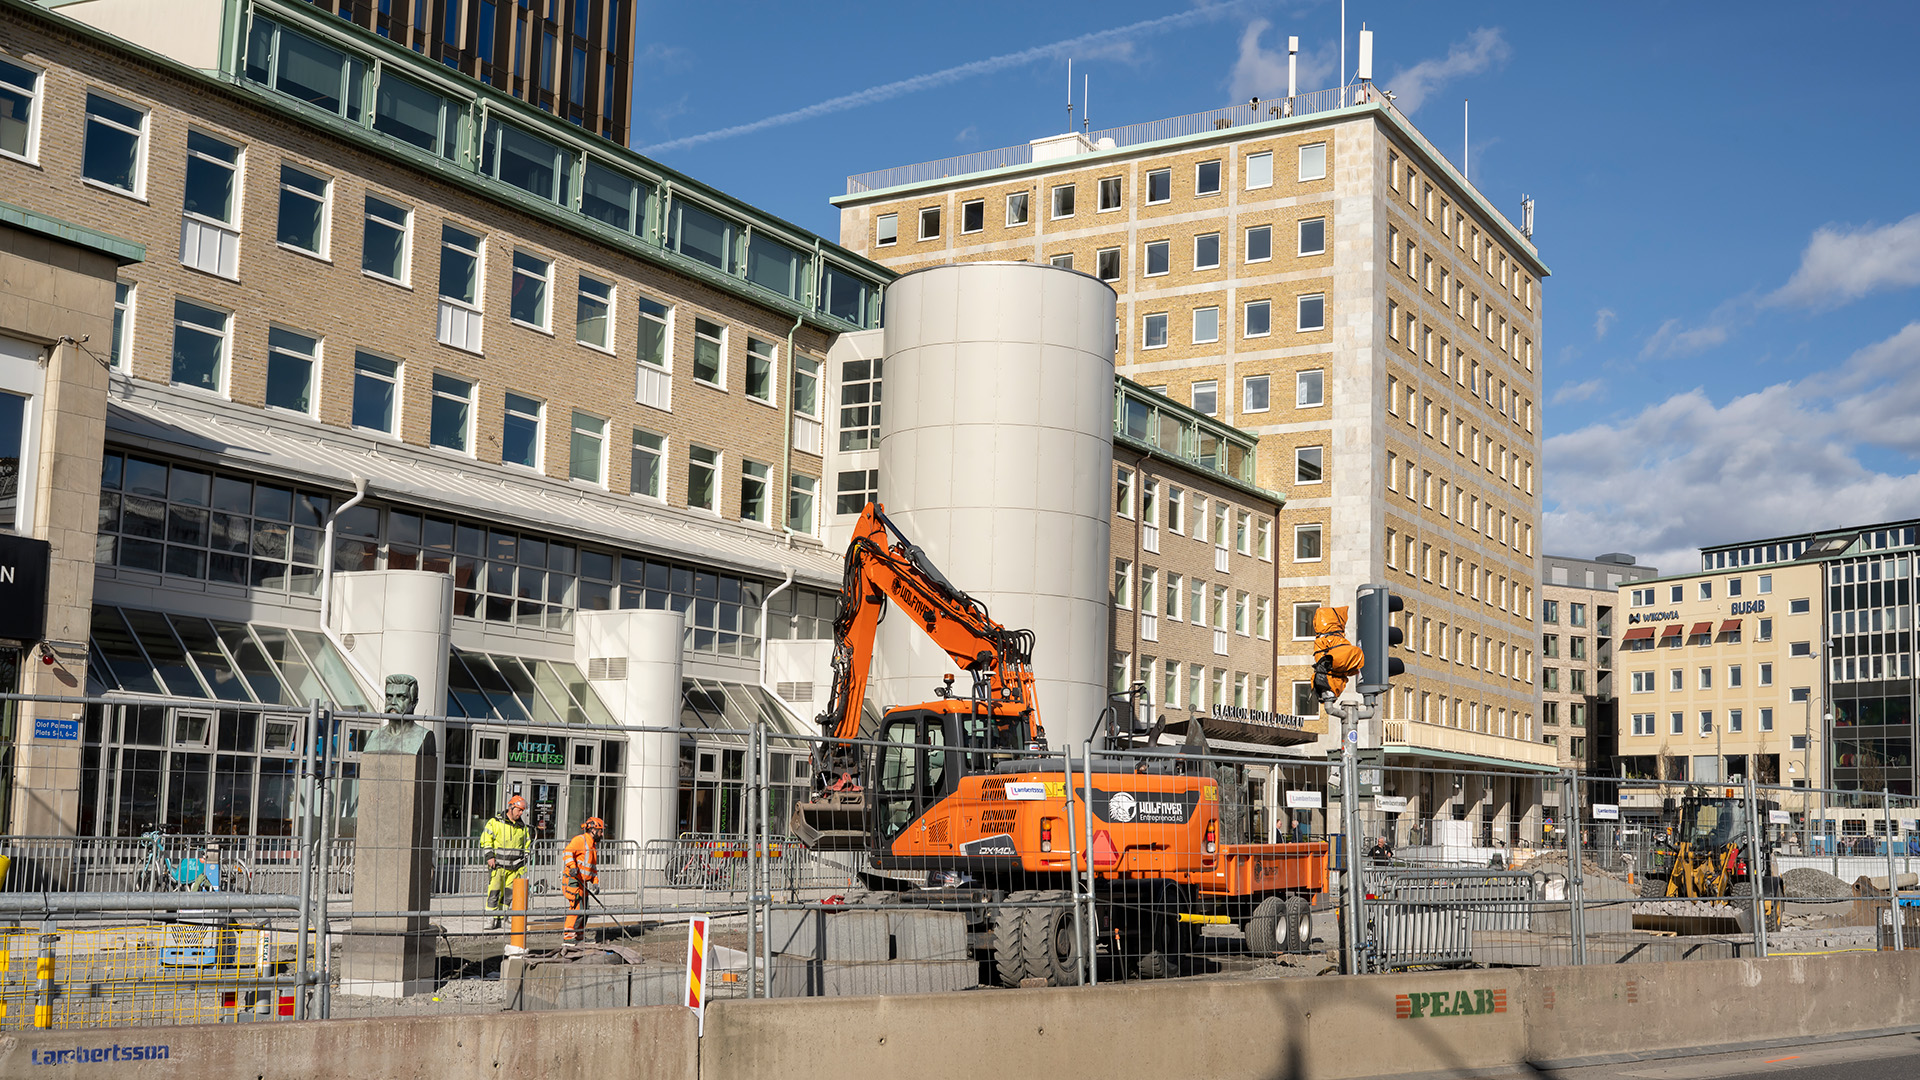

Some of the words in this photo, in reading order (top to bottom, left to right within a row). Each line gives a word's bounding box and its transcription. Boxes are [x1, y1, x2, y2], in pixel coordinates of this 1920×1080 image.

[900, 585, 930, 615] WOLFMY
[509, 752, 564, 764] WELLNESS
[517, 741, 556, 753] NORDC
[1408, 989, 1495, 1018] PEAB
[31, 1044, 170, 1066] Lambertsson
